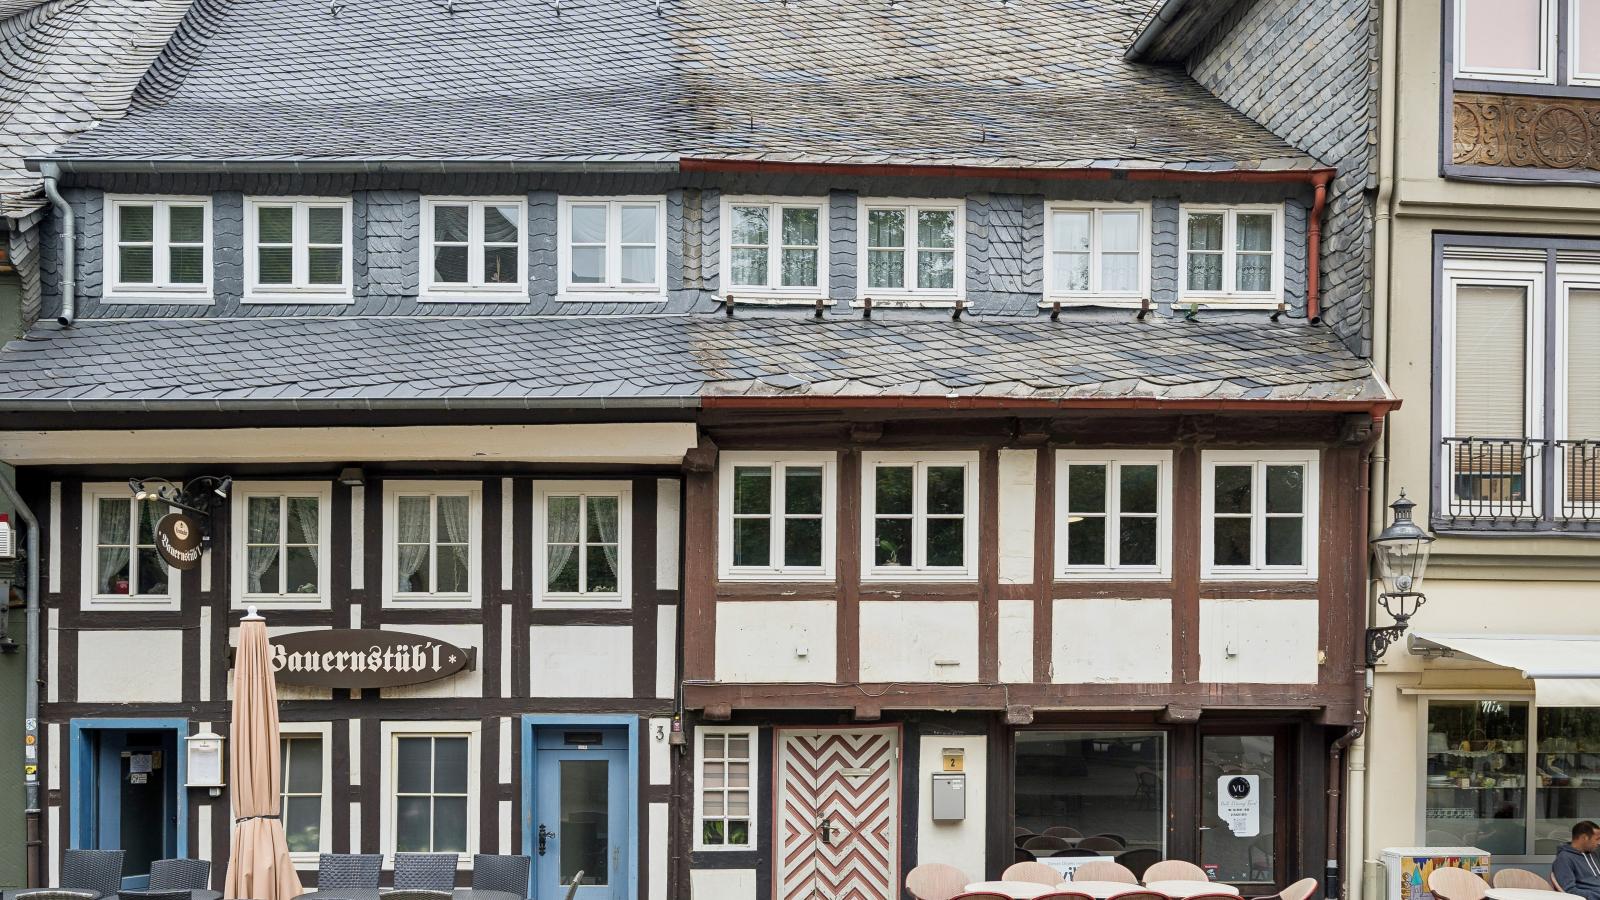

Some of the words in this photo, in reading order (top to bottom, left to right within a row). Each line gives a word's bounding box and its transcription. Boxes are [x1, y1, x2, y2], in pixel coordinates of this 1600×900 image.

[269, 642, 442, 673] Bauernstüb'l
[655, 725, 664, 741] 3
[950, 758, 955, 767] 2
[1232, 784, 1245, 793] VU
